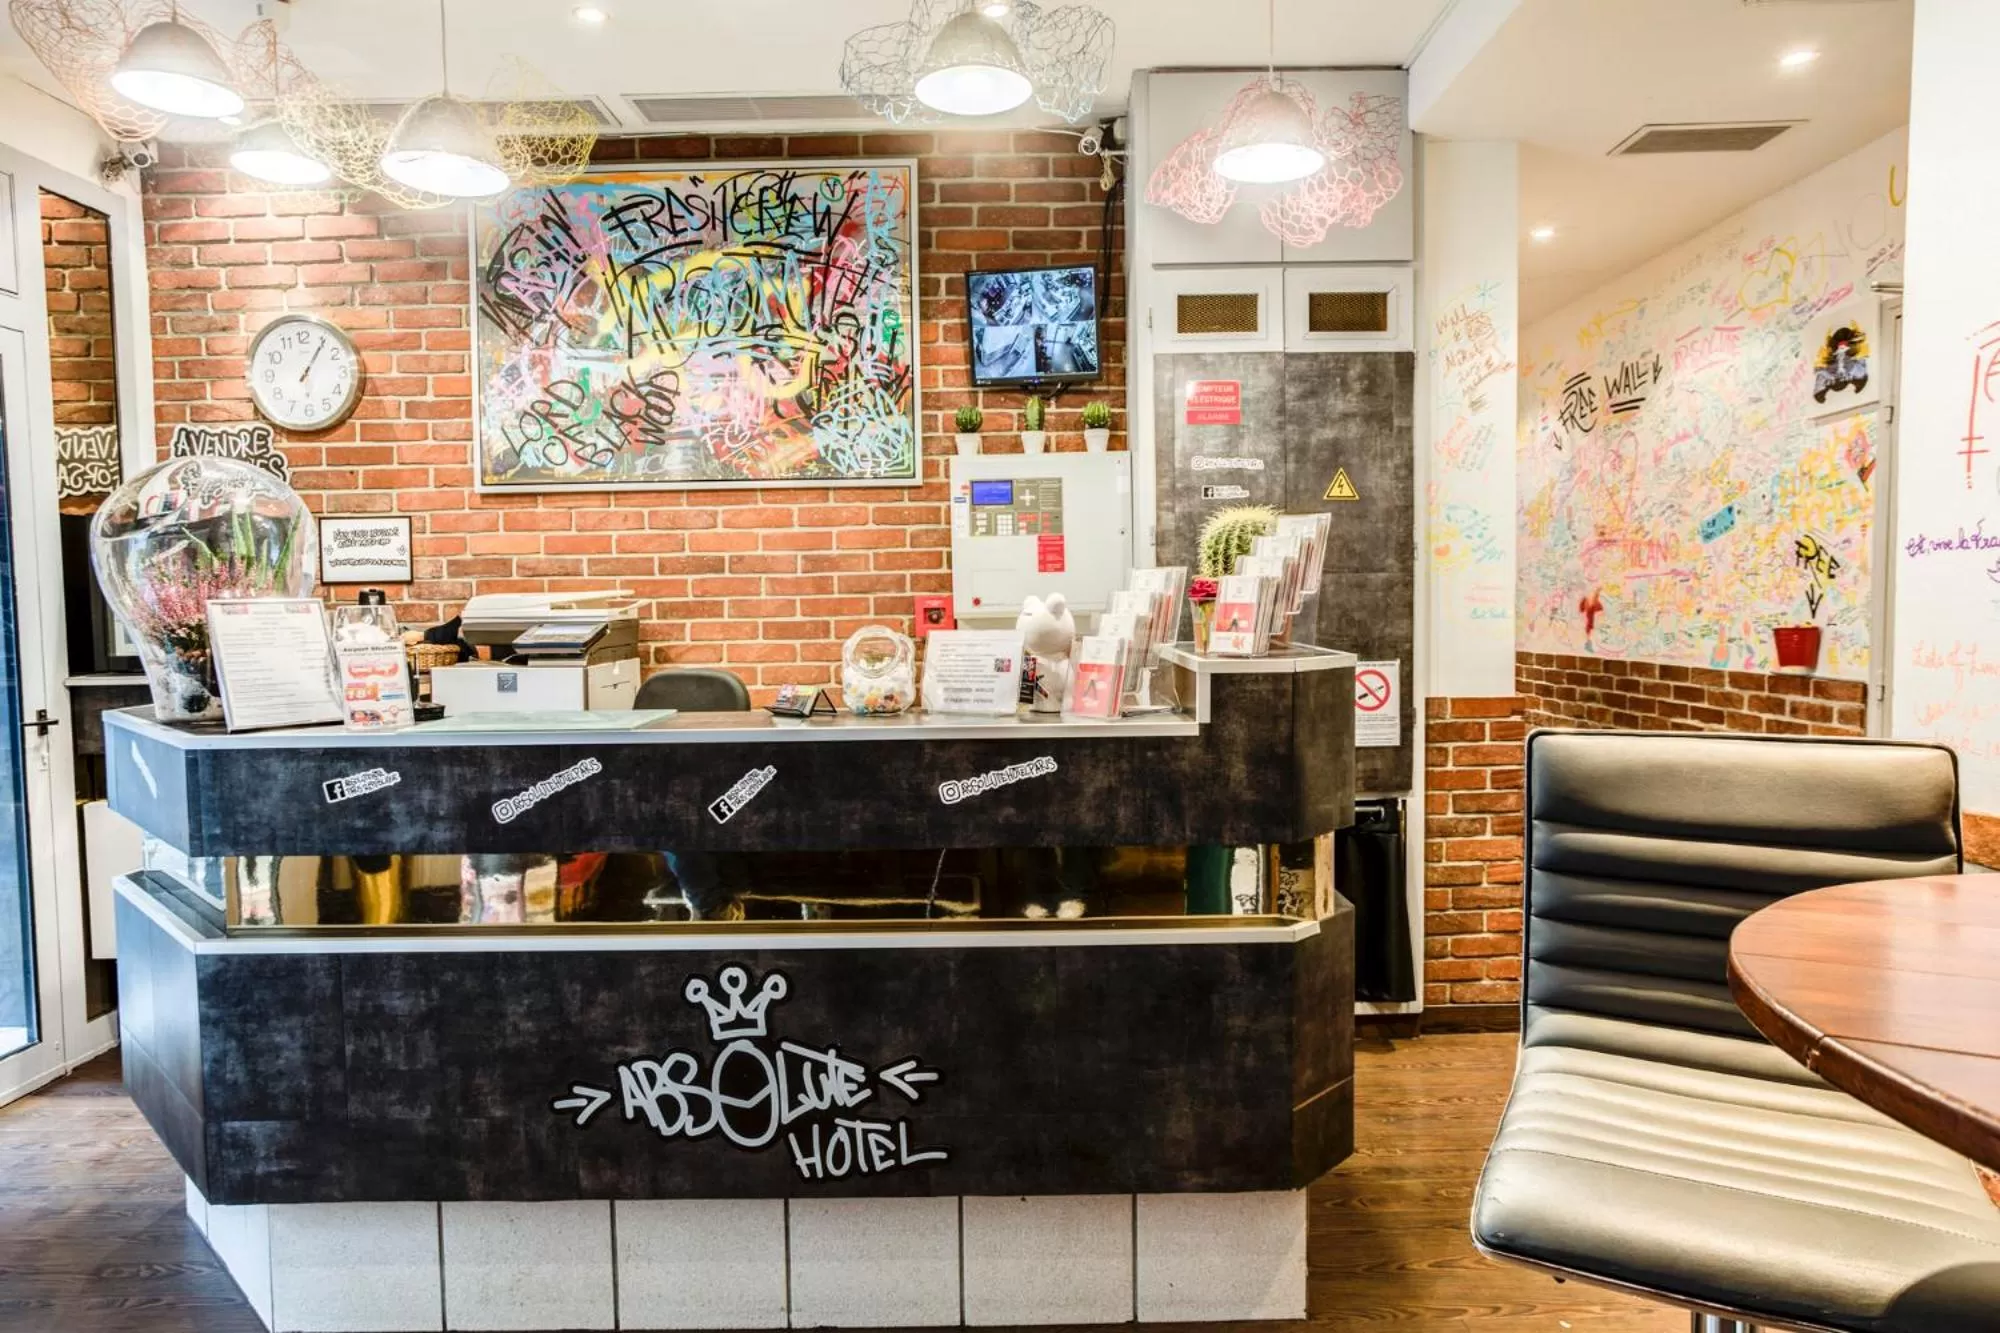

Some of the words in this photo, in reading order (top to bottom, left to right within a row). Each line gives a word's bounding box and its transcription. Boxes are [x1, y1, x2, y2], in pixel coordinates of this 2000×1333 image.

[280, 337, 293, 349] 11
[296, 330, 310, 344] 12
[265, 350, 282, 364] 10
[330, 347, 340, 360] 2
[264, 369, 275, 383] 9
[338, 365, 348, 378] 3
[1603, 360, 1649, 399] WALL
[273, 387, 283, 400] 8
[332, 384, 341, 395] 4
[288, 400, 297, 416] 7
[304, 403, 314, 417] 6
[322, 398, 332, 411] 5
[617, 1039, 872, 1148] ABSOLUTE
[788, 1118, 948, 1178] HOTEL
